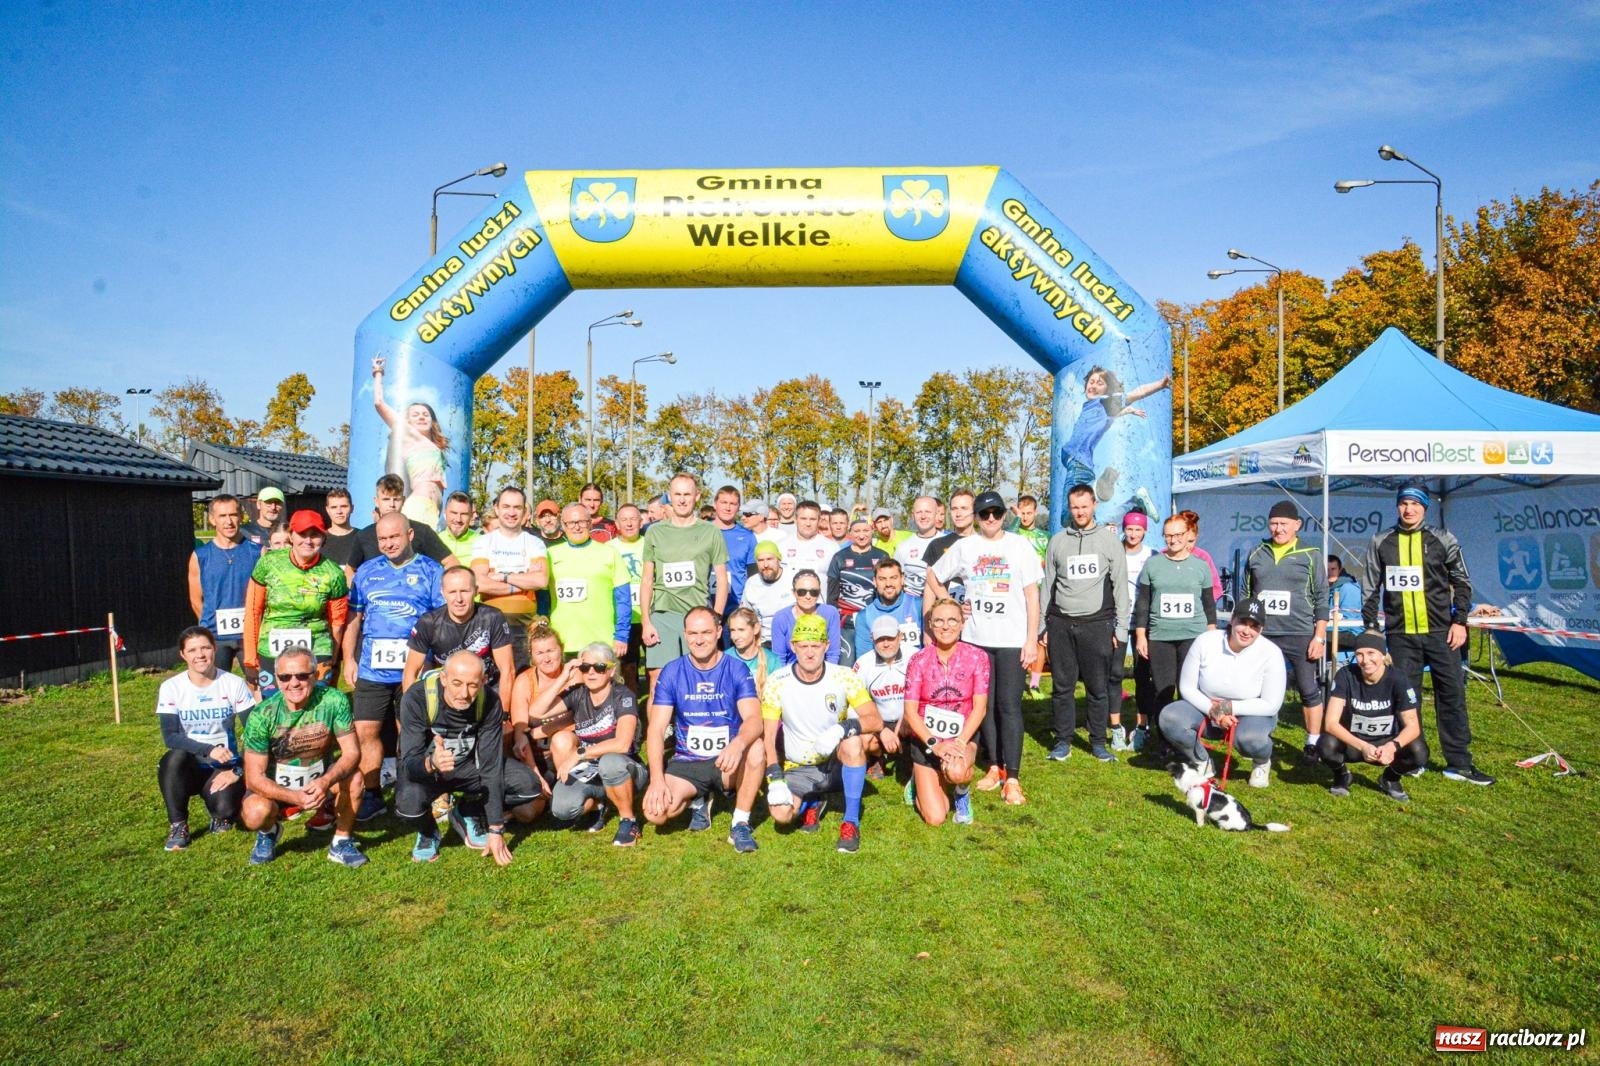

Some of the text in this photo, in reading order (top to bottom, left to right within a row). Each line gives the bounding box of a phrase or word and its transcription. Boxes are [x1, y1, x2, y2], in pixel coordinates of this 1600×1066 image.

[696, 175, 822, 190] Gmina
[686, 222, 831, 247] Wielkie
[390, 200, 522, 321] Gmina ludzi
[1002, 198, 1135, 323] Gmina ludzi
[417, 228, 543, 343] aktywnych
[980, 226, 1106, 344] aktywnych
[1348, 442, 1475, 463] PersonalBest
[1069, 563, 1097, 575] 166
[665, 571, 693, 583] 303
[1388, 575, 1420, 587] 159
[557, 586, 585, 599] 337
[974, 600, 1005, 614] 192
[1162, 602, 1192, 613] 318
[220, 618, 245, 630] 18
[375, 650, 407, 663] 151
[925, 716, 960, 735] 309
[1355, 722, 1391, 732] 157
[690, 737, 726, 751] 305
